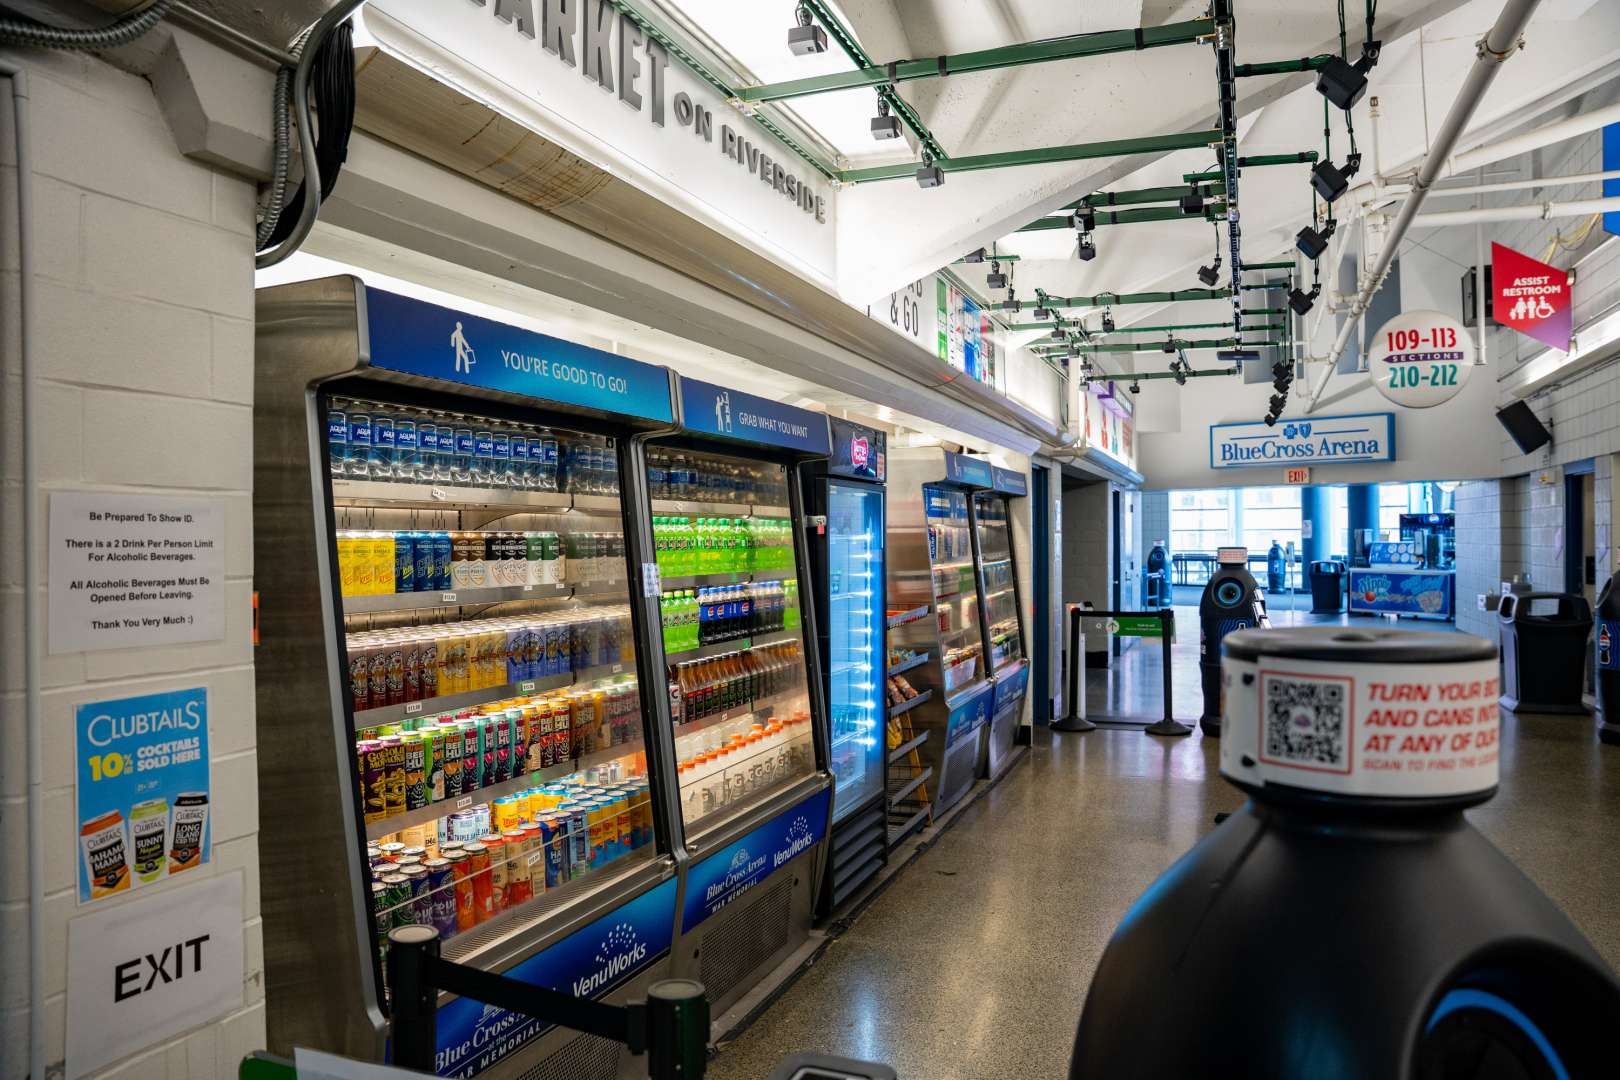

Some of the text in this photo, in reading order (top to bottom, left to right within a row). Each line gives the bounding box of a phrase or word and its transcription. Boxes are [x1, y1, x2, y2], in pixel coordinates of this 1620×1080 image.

[471, 0, 826, 225] RKET ON RIVERSIDE
[1502, 285, 1561, 297] RESTROOM
[1513, 276, 1550, 287] ASSIST
[904, 295, 918, 337] GO
[1387, 328, 1457, 352] 109-113
[1392, 352, 1459, 362] SECTIONS
[501, 350, 628, 395] YOU'RE GOOD TO GO!
[1389, 364, 1458, 388] 210-212
[738, 412, 808, 439] GRAB WHAT YOU WANT
[1221, 437, 1379, 462] BlueCross Arena
[1288, 470, 1304, 483] EXIT
[89, 512, 195, 523] Be Prepared To Show ID.
[65, 539, 213, 549] There is a 2 Drink Per Person Limit
[88, 552, 196, 563] For Alcoholic Beverages.
[70, 576, 210, 590] All Alcoholic Beverages Must Be
[90, 590, 195, 605] Opened Before Leaving.
[91, 619, 120, 630] Thank
[123, 618, 140, 628] You
[142, 616, 161, 628] Very
[163, 615, 185, 626] Much
[1367, 682, 1431, 702] TURN
[1437, 680, 1481, 701] YOUR
[87, 700, 201, 747] CLUBTAILS
[1364, 708, 1420, 728] AND
[1423, 707, 1474, 728] CANS
[136, 736, 200, 759] COCKTAILS
[1364, 734, 1396, 753] AT
[1399, 733, 1446, 753] ANY
[1450, 732, 1473, 751] OF
[136, 755, 170, 772] SOLD
[171, 748, 201, 765] HERE
[175, 830, 200, 839] ISLAND
[177, 823, 200, 833] LONG
[136, 835, 164, 849] SUNNY
[774, 832, 813, 867] VenuWorks
[94, 852, 122, 871] MAMA
[707, 882, 724, 901] Blue
[725, 868, 746, 888] Cross
[748, 855, 767, 873] Arena
[711, 899, 725, 914] WAR
[727, 877, 757, 903] MEMORIAL
[114, 934, 211, 1003] EXIT
[573, 942, 647, 998] VenuWorks
[435, 1012, 516, 1073] Blue Cross
[480, 1021, 541, 1069] MEMORIAL
